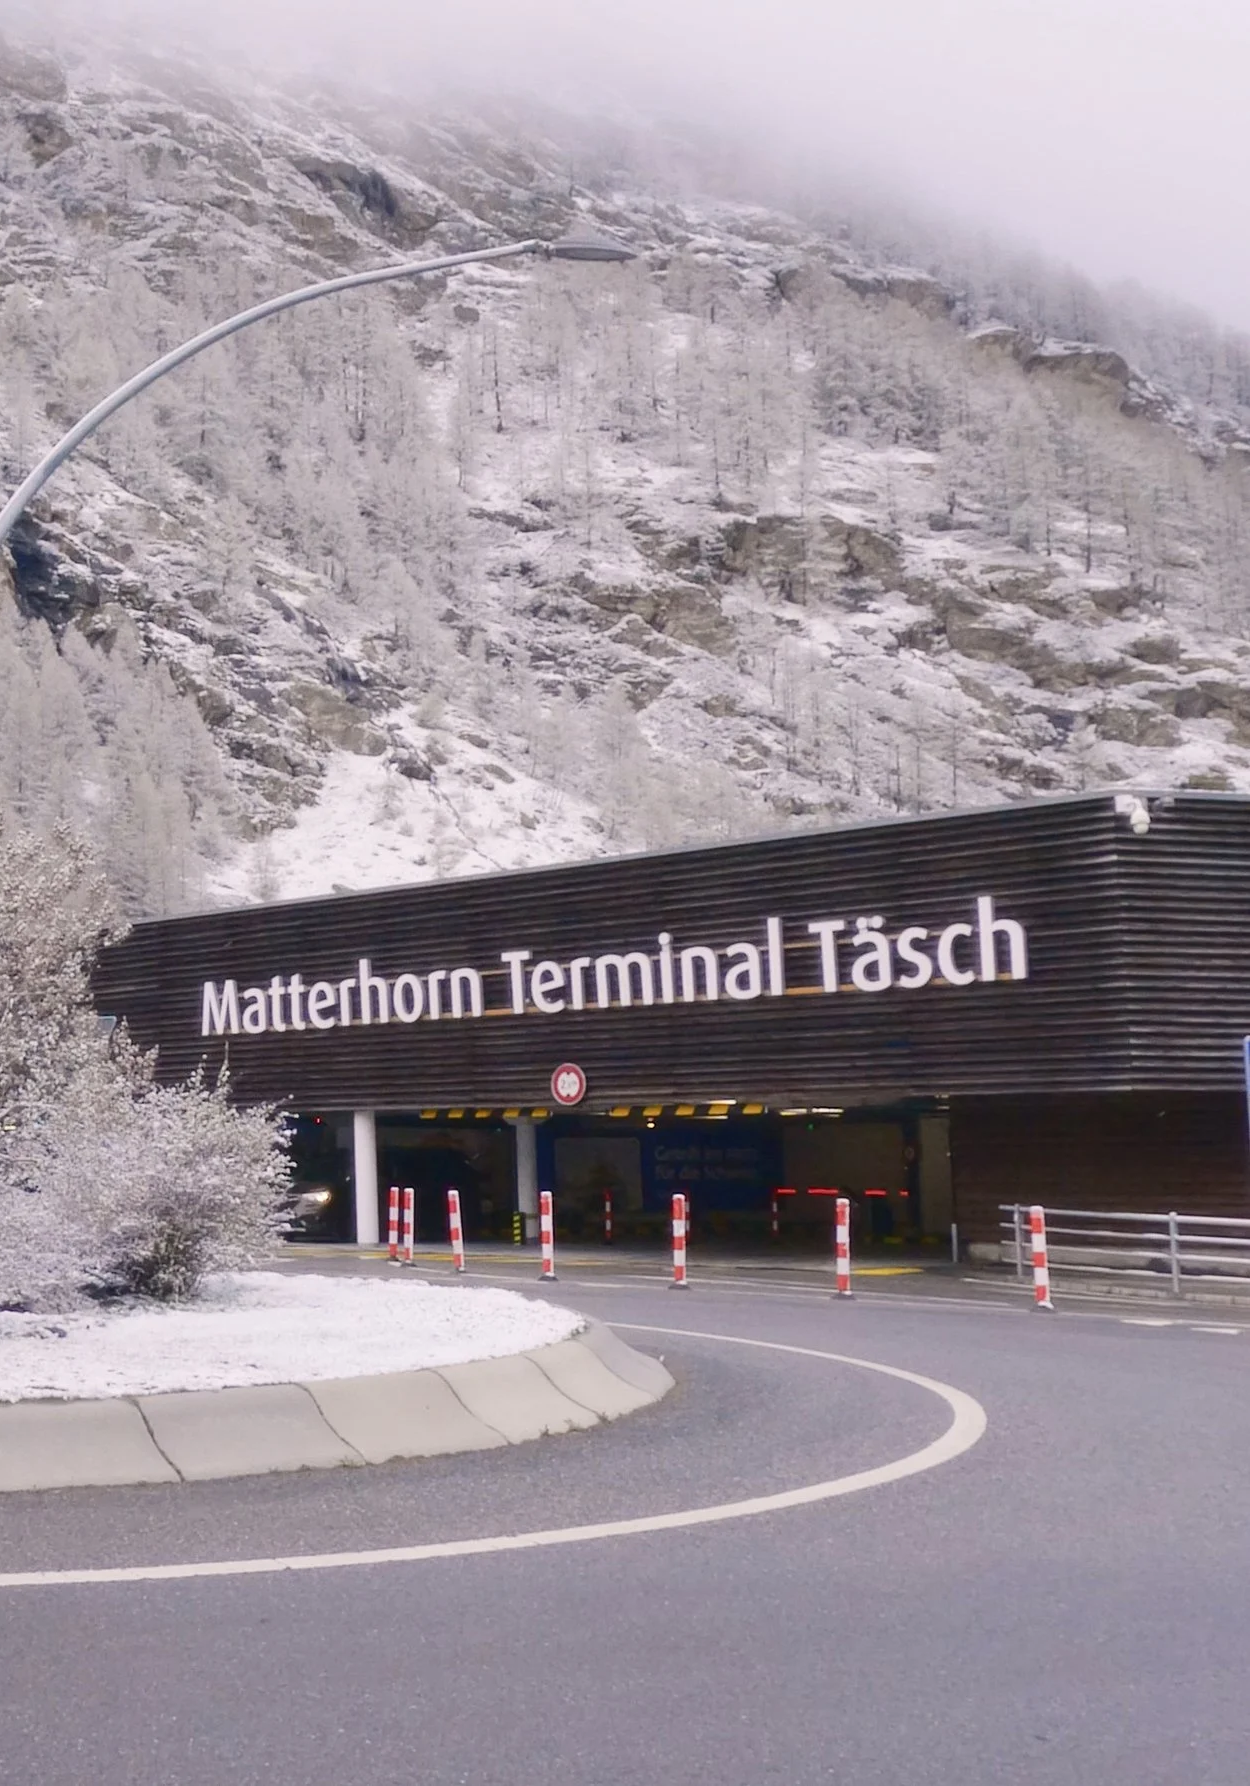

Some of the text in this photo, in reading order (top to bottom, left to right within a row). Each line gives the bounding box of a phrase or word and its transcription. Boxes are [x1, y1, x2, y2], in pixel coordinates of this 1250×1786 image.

[201, 896, 1029, 1036] Matterhorn Terminal Täsch
